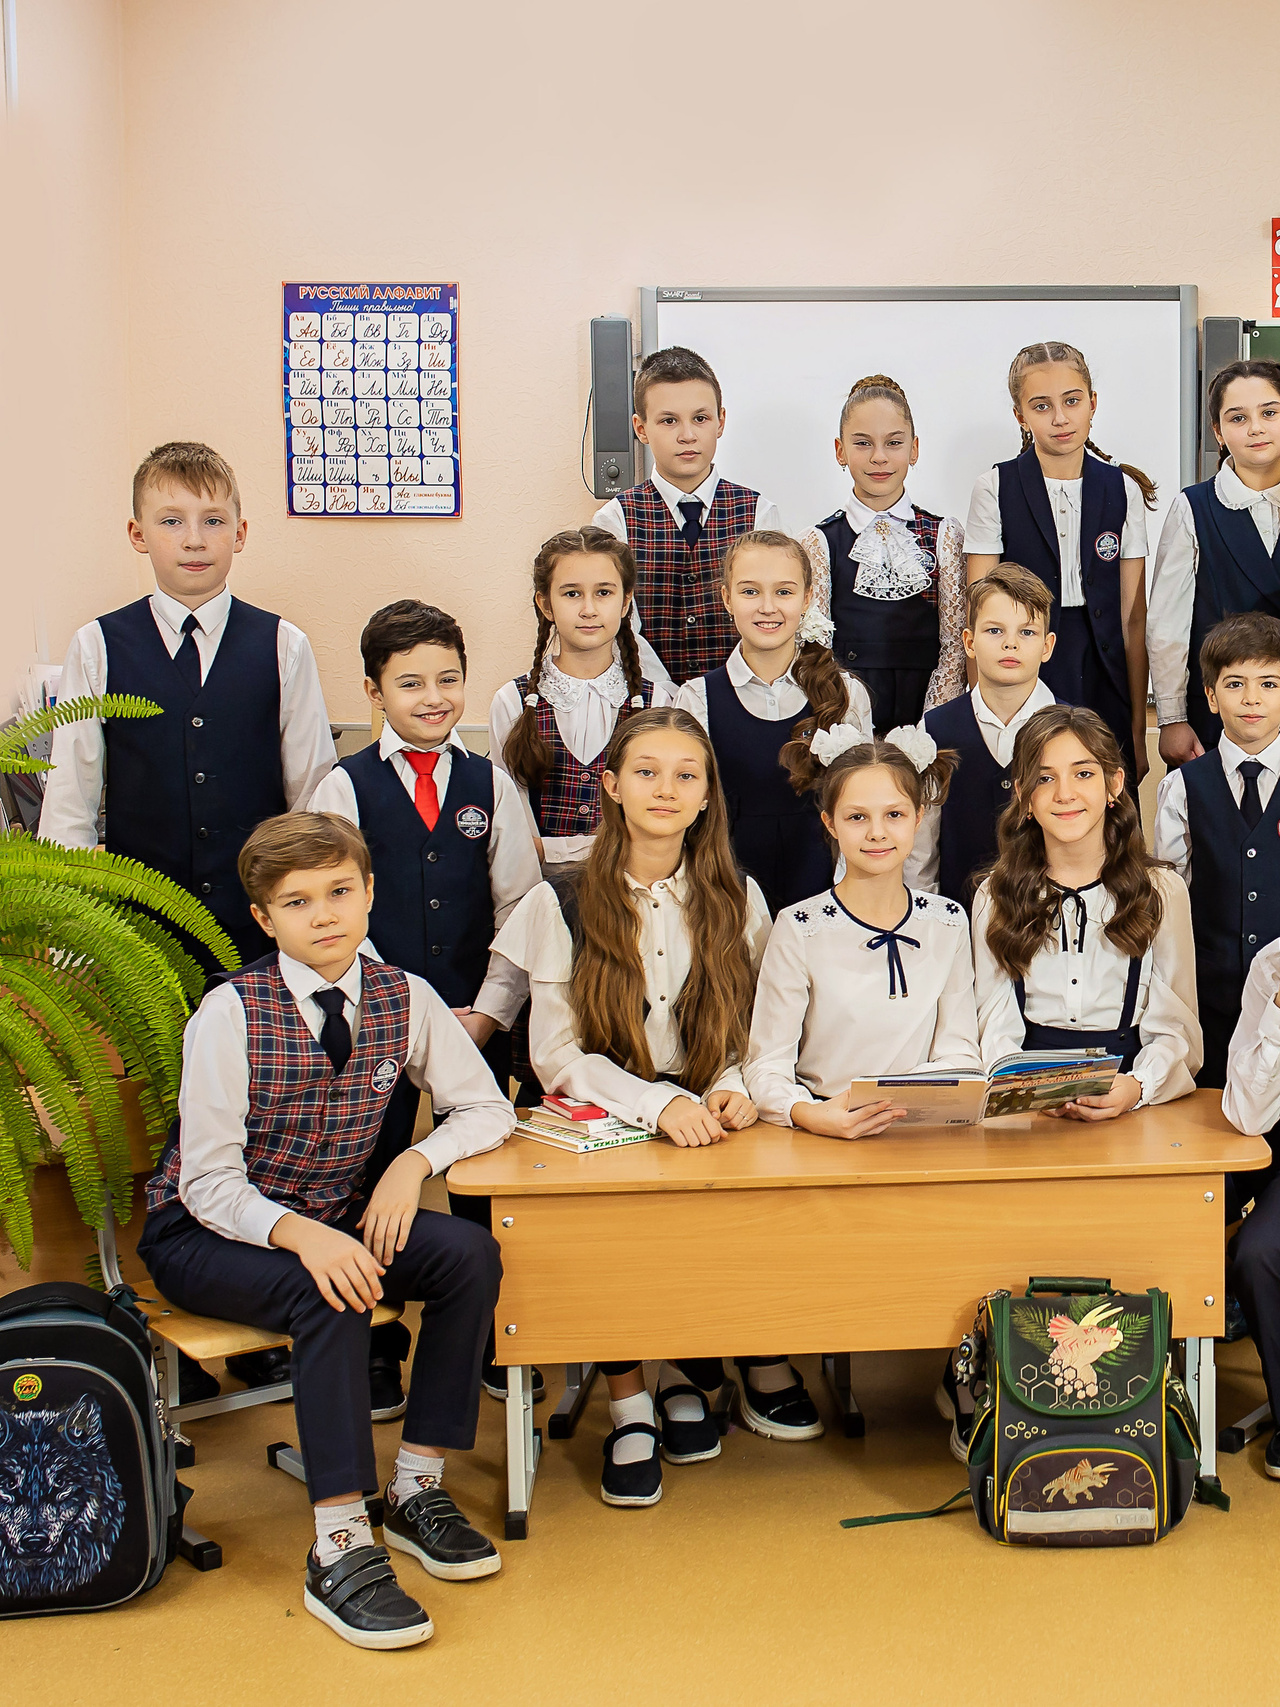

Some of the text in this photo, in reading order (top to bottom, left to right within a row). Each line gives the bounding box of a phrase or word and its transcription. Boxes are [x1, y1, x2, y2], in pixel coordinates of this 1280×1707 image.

[299, 285, 442, 300] РУССКИЙ АЛФАВИТ
[662, 290, 685, 298] SMART
[330, 300, 416, 313] Пиши правильно!
[593, 1139, 619, 1148] СТИХИ
